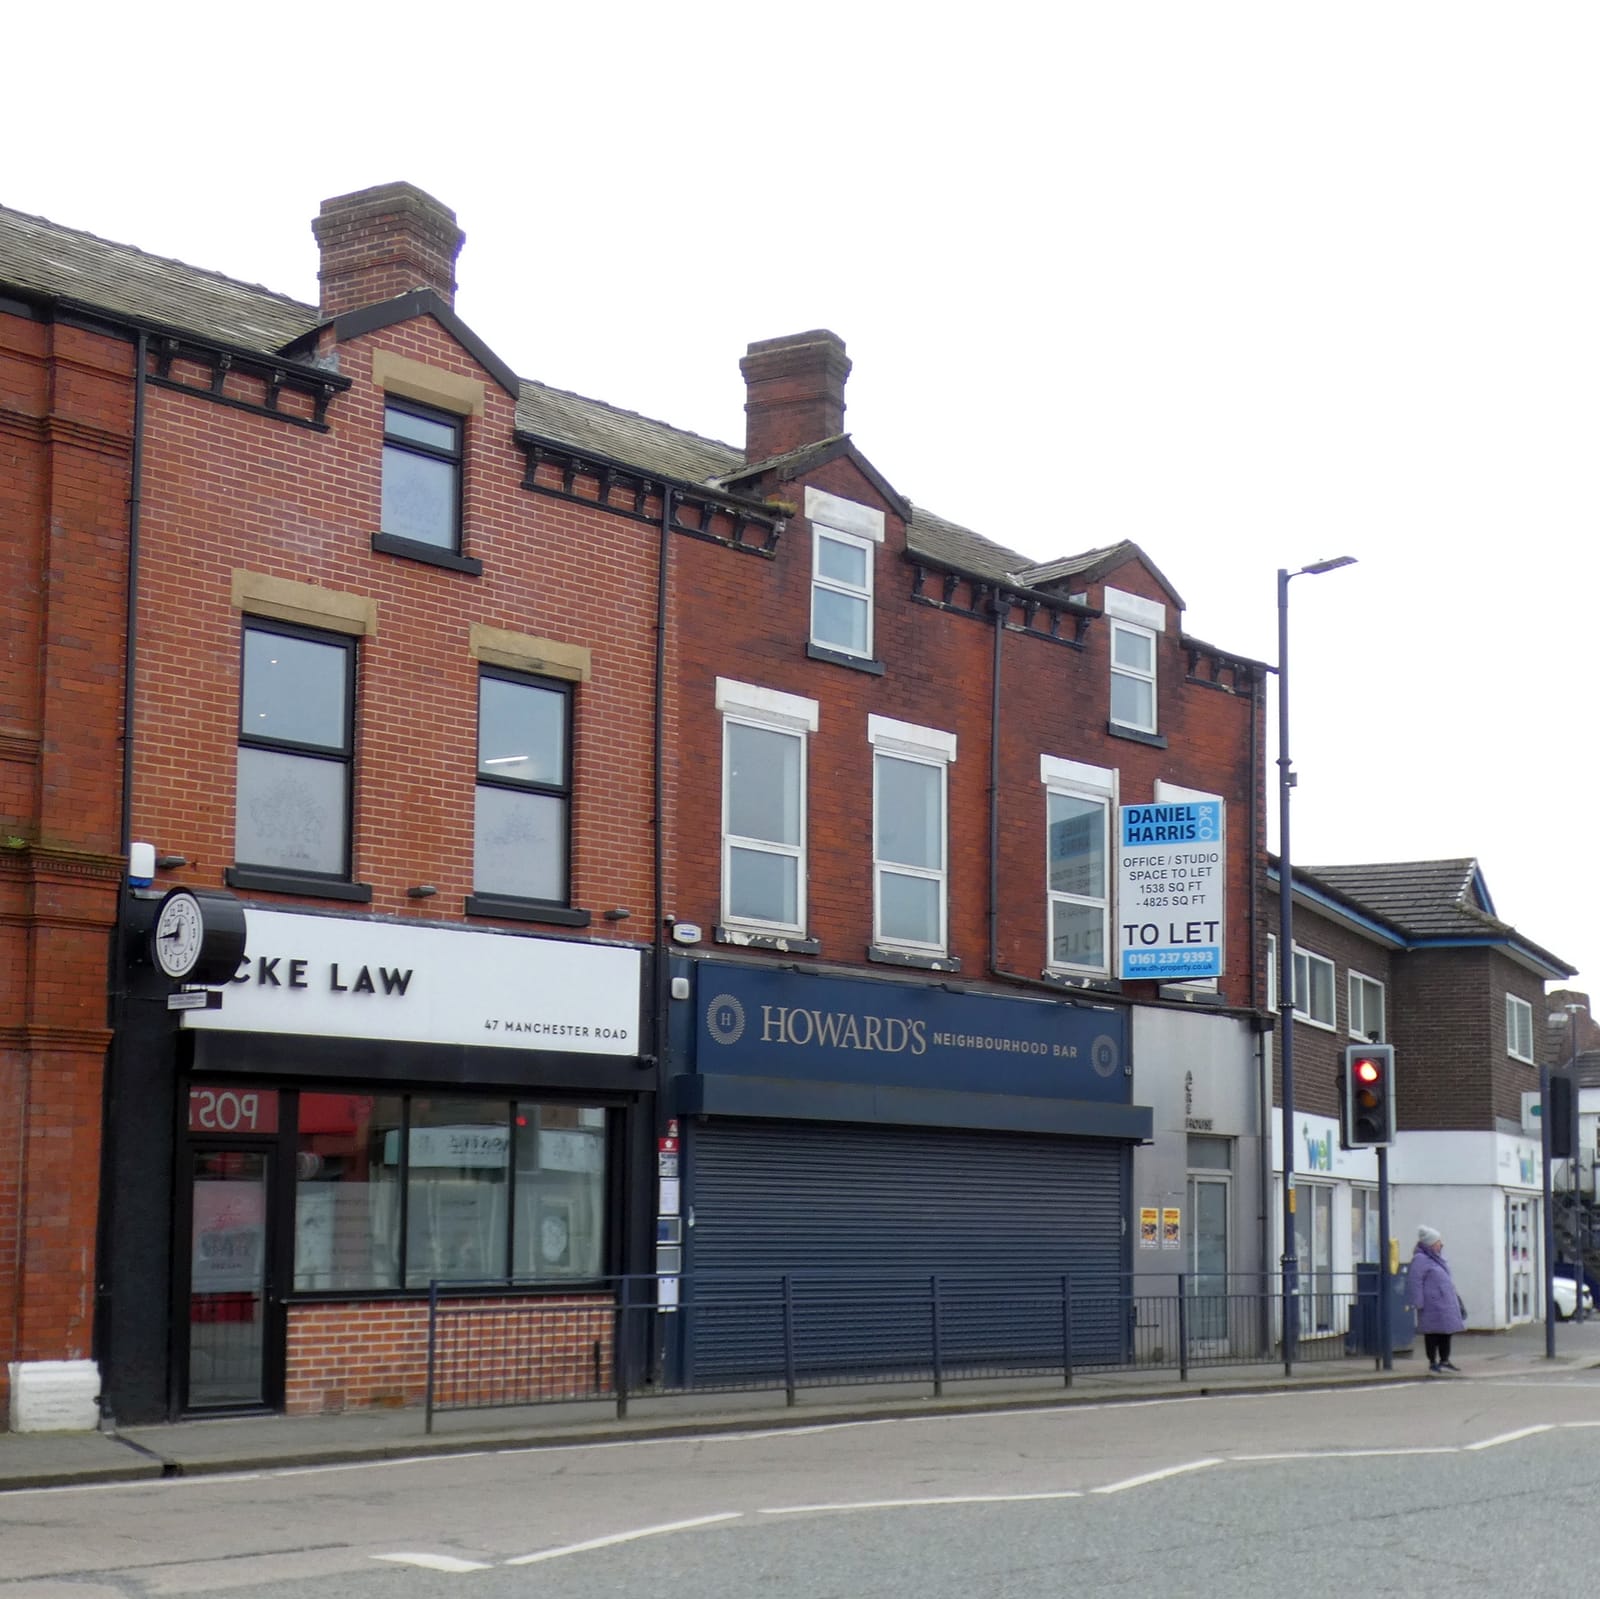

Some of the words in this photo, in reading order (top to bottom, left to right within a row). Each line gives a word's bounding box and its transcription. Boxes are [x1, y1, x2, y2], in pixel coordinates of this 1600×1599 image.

[1128, 806, 1196, 824] DANIEL
[1199, 805, 1213, 840] &CO
[1128, 824, 1196, 842] HARRIS
[1123, 856, 1165, 868] OFFICE
[1175, 853, 1219, 865] STUDIO
[1129, 869, 1168, 881] SPACE
[1171, 868, 1187, 879] TO
[1190, 867, 1213, 878] LET
[1140, 883, 1165, 894] 1538
[1168, 882, 1184, 892] SQ
[1188, 881, 1203, 891] FT
[1143, 897, 1169, 907] 4825
[1172, 896, 1188, 906] SQ
[1192, 895, 1206, 905] FT
[1123, 923, 1159, 946] TO
[1169, 921, 1220, 944] LET
[1128, 953, 1156, 965] 0161
[1159, 952, 1181, 964] 237
[1183, 951, 1214, 963] 9393
[1129, 963, 1213, 973] www.dh-property.co.uk
[330, 962, 414, 997] LAW
[484, 1019, 499, 1031] 47
[505, 1021, 590, 1037] MANCHESTER
[595, 1027, 628, 1040] ROAD
[760, 1004, 927, 1055] HOWARD'S
[933, 1031, 1048, 1056] NEIGHBOURHOOD
[1053, 1044, 1078, 1059] BAR
